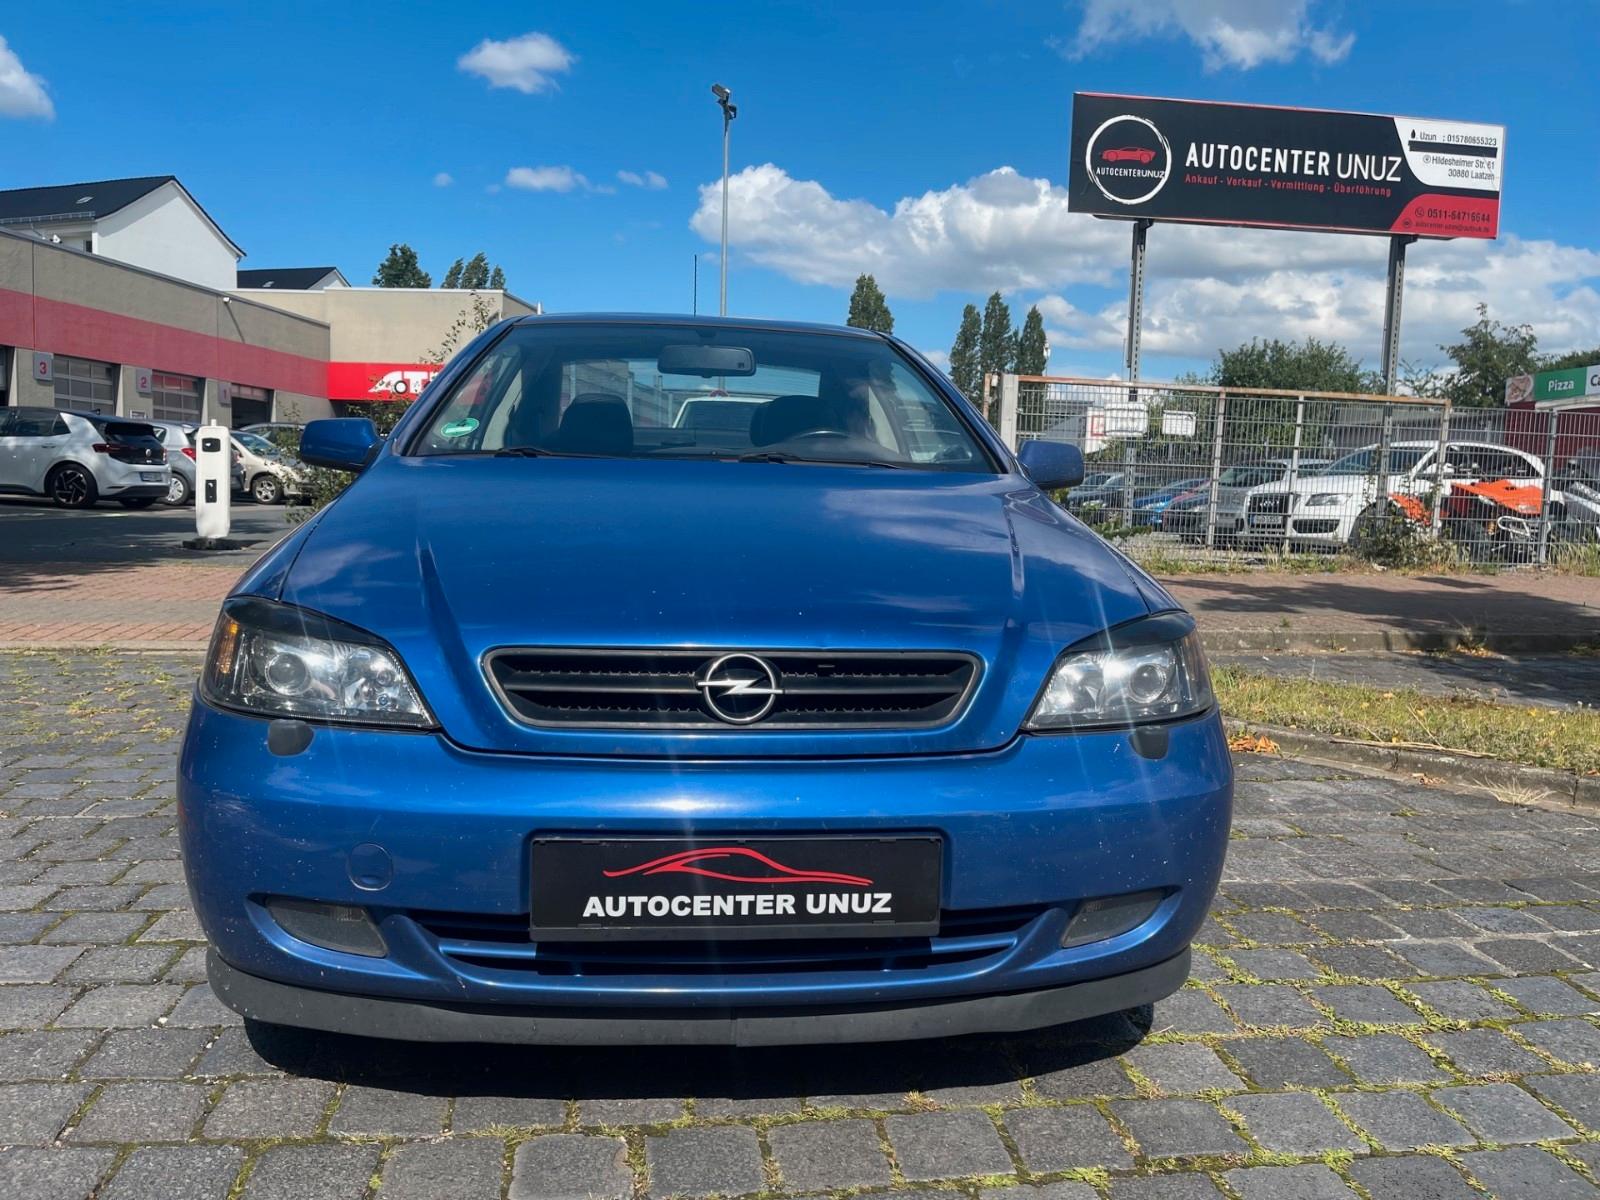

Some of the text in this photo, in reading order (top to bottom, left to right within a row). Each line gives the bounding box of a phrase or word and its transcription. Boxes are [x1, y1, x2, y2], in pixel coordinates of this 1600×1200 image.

[1185, 142, 1402, 182] AUTOCENTER UNUZ
[1432, 156, 1474, 168] Hildesheimer
[1475, 159, 1485, 168] Str.
[1470, 170, 1495, 181] Laatzen
[1184, 173, 1218, 185] Ankauf
[1226, 176, 1262, 188] Verkauf
[1270, 180, 1325, 193] Vermittlung
[1334, 182, 1392, 198] Überführung
[39, 362, 47, 374] 3
[140, 376, 147, 388] 2
[1548, 379, 1574, 392] Pizza
[582, 893, 892, 917] AUTOCENTER UNUZ
